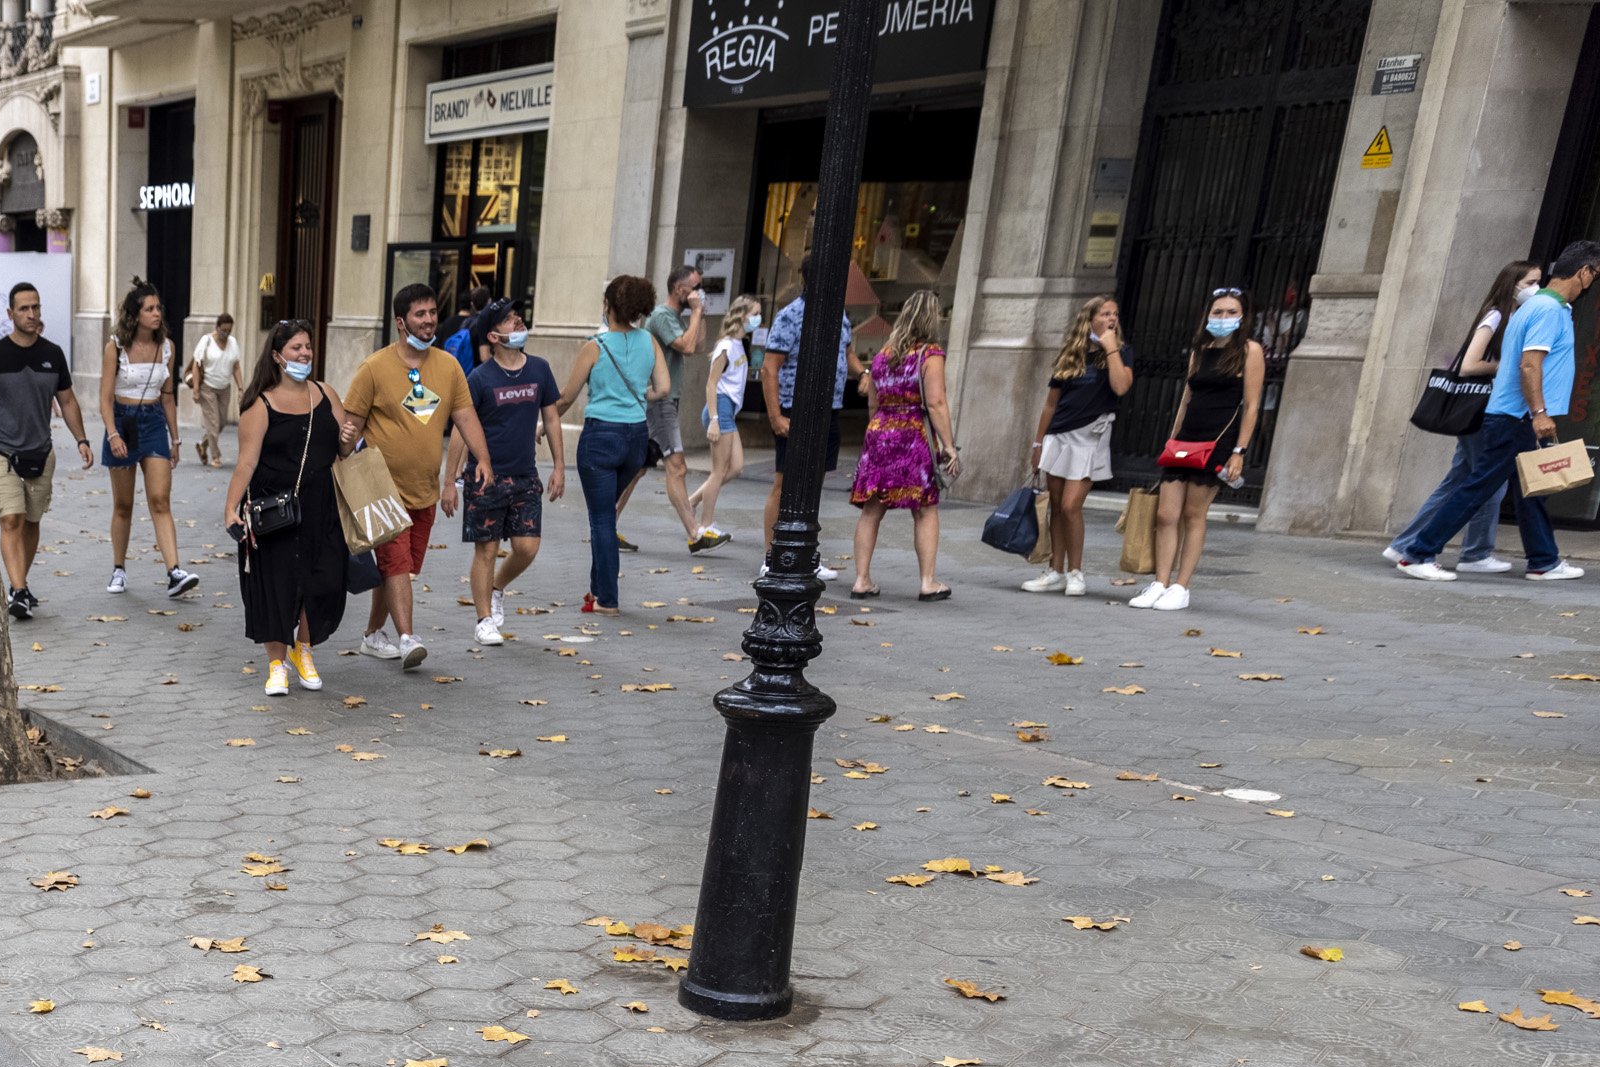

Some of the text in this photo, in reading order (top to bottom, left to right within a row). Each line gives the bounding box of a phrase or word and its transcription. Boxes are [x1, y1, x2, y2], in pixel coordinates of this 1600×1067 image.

[808, 0, 973, 46] PEUMERIA
[705, 34, 776, 79] REGIA
[434, 85, 553, 122] BRANDY MELVILLE
[353, 495, 414, 542] ZARA
